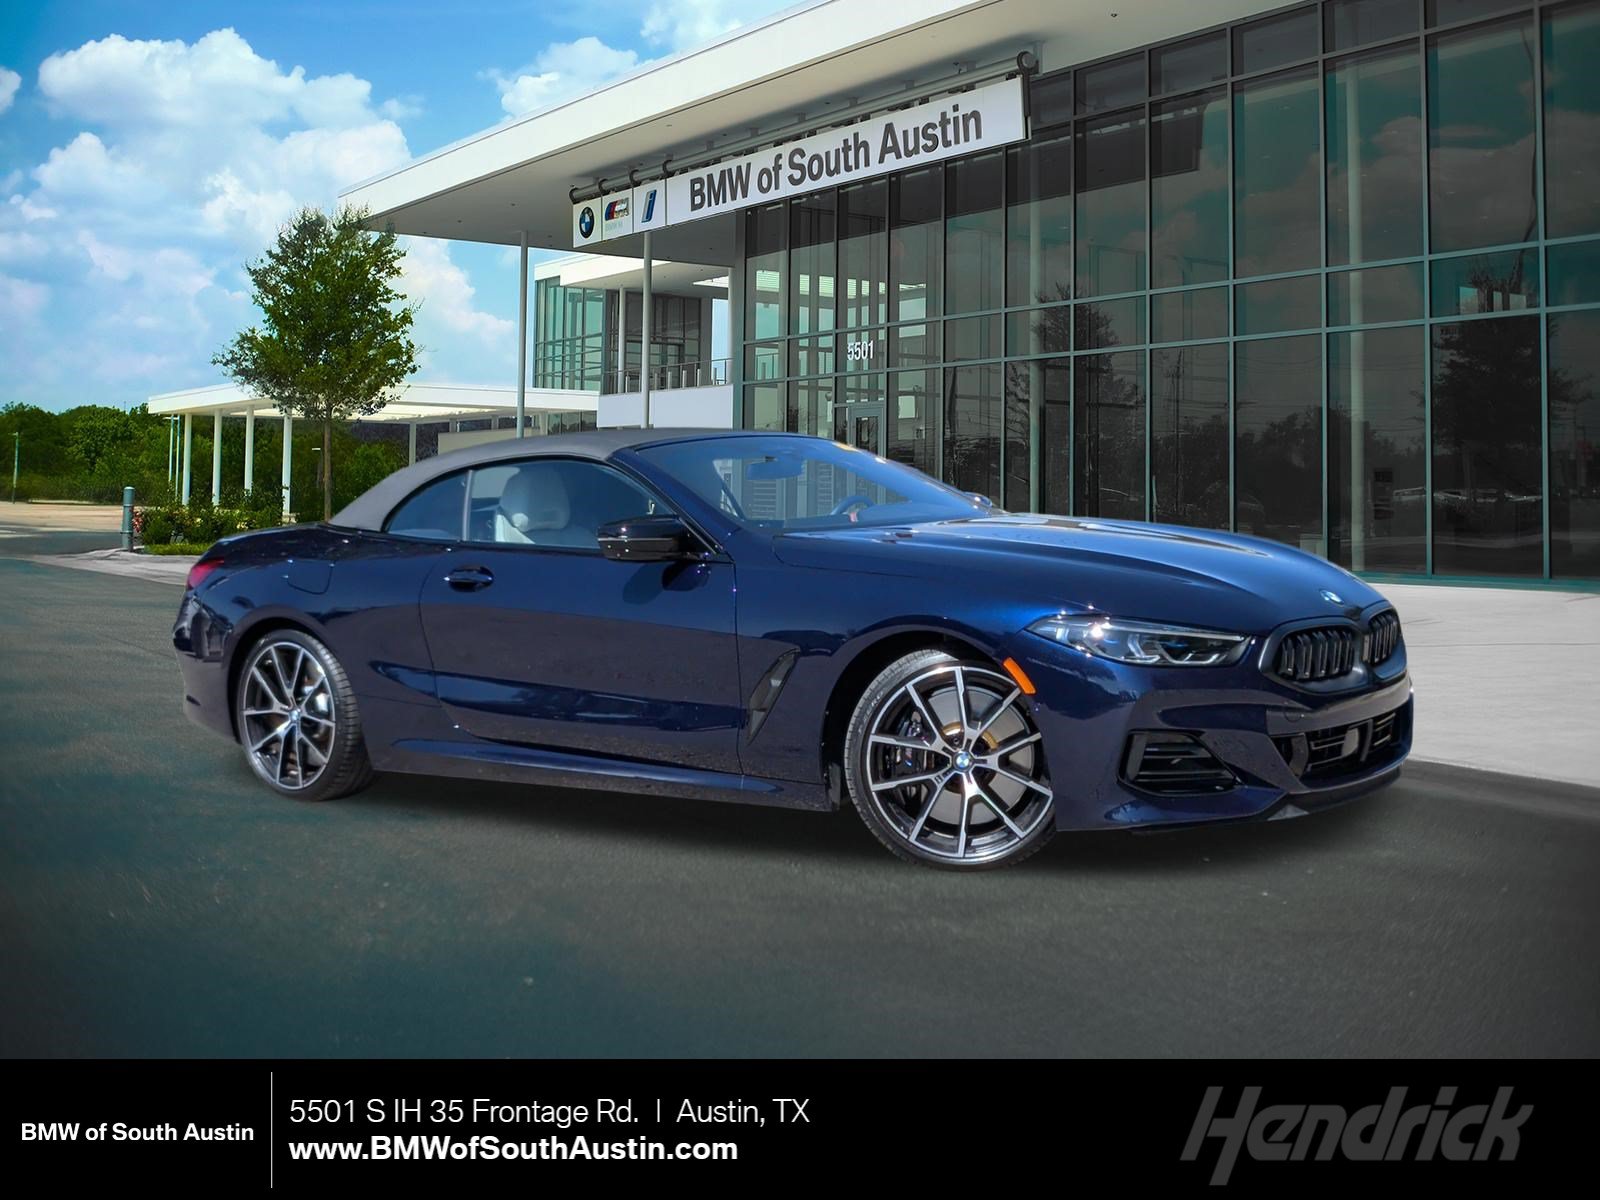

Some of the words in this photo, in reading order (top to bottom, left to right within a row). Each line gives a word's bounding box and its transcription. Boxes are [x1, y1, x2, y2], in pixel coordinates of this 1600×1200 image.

[690, 163, 751, 211] BMW
[757, 153, 783, 194] of
[787, 133, 870, 186] South
[878, 105, 983, 164] Austin
[847, 340, 874, 361] 5501
